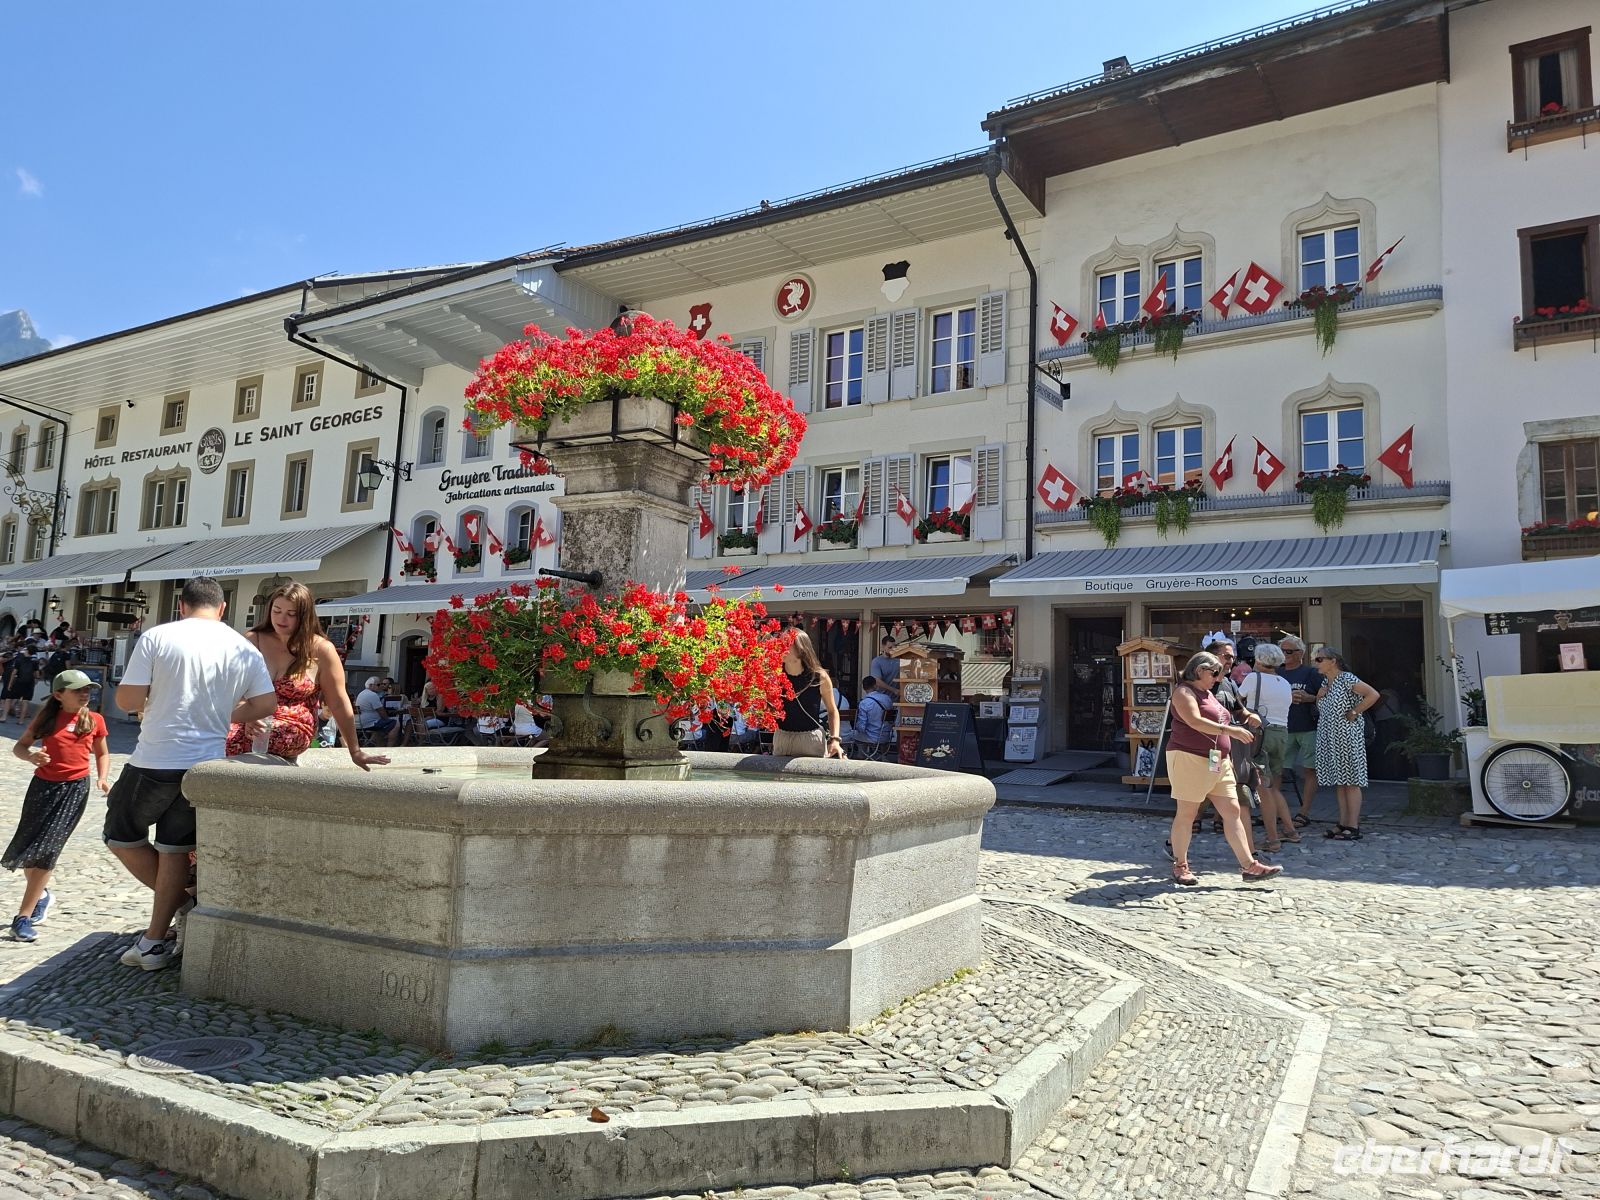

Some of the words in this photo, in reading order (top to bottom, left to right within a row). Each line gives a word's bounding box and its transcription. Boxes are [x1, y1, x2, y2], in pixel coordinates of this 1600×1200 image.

[234, 432, 253, 446] LE
[260, 422, 303, 441] SAINT
[310, 406, 383, 432] GEORGES
[84, 455, 116, 469] HÔTEL
[121, 442, 193, 463] RESTAURANT
[439, 470, 491, 491] Gruyère
[492, 464, 556, 481] Traditn
[445, 489, 502, 504] Fabrications
[504, 481, 555, 495] artisanales
[823, 588, 859, 597] Fromage
[864, 586, 909, 596] Meringues
[1085, 581, 1134, 592] Boutique
[1145, 577, 1238, 591] Gruyère-Rooms
[1252, 574, 1309, 585] Cadeaux
[348, 606, 374, 614] Restaurant
[379, 970, 428, 1003] 1980
